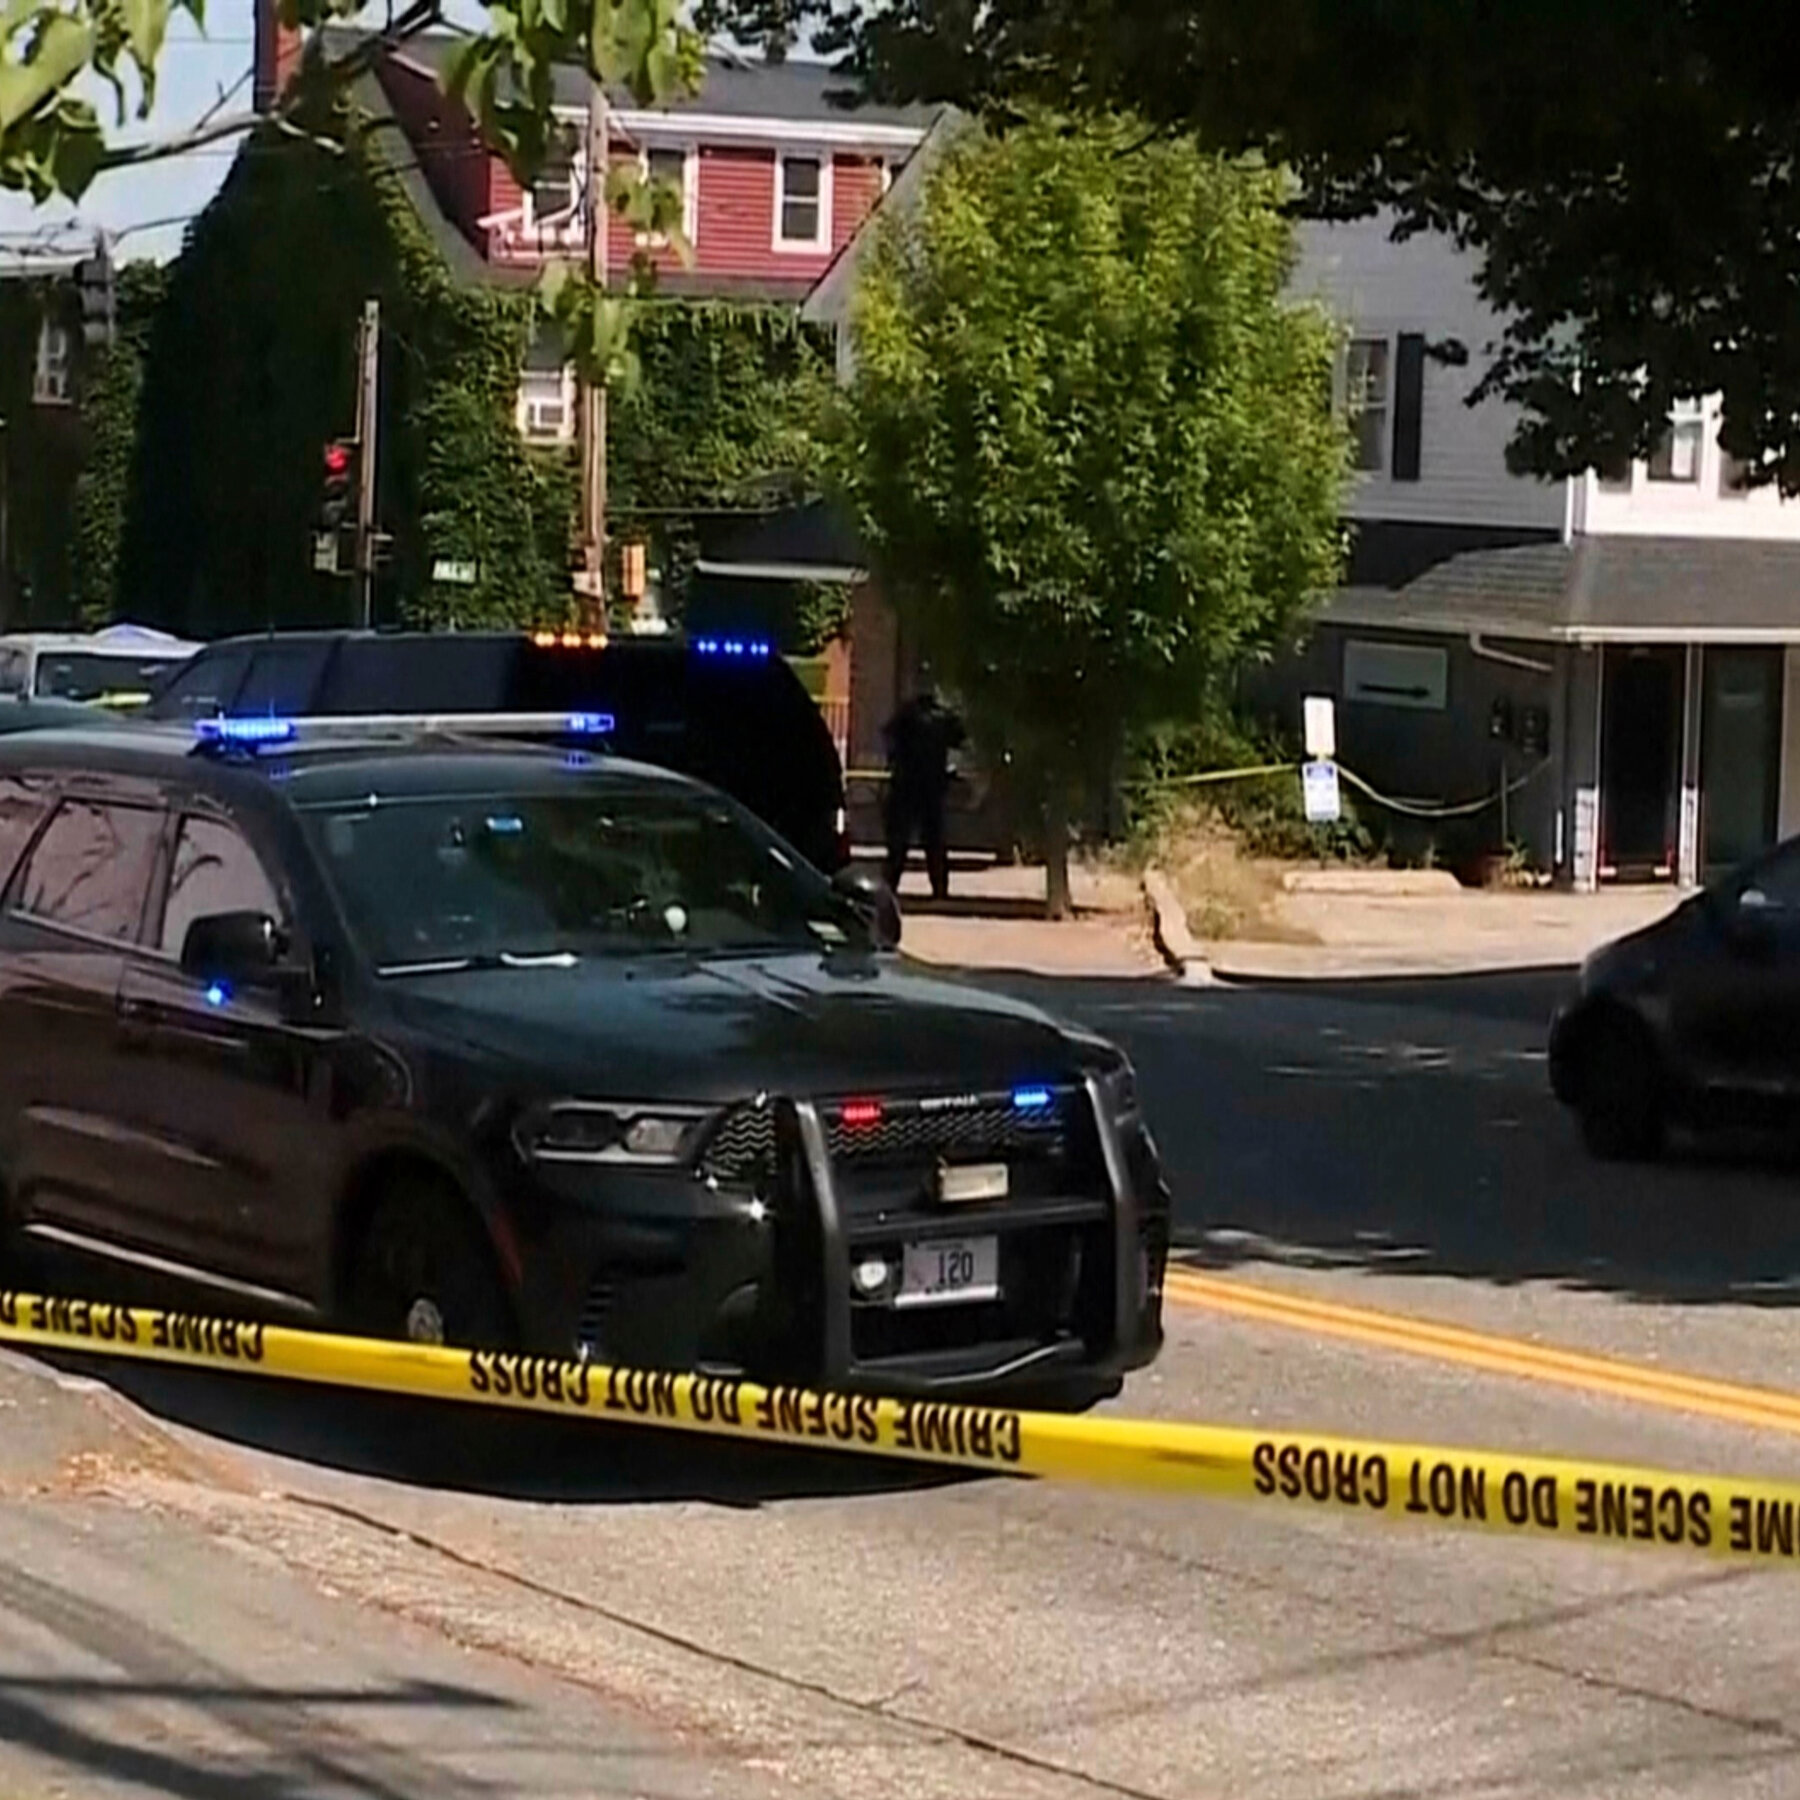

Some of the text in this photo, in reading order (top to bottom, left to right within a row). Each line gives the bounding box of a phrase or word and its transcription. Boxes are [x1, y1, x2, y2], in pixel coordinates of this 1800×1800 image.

[938, 1251, 974, 1285] 120
[30, 1299, 138, 1343] SCENE
[151, 1312, 266, 1361] CRIME
[469, 1350, 1021, 1462] CRIME SCENE DO NOT CROSS
[1252, 1441, 1800, 1556] ME SCENE DO NOT CROSS
